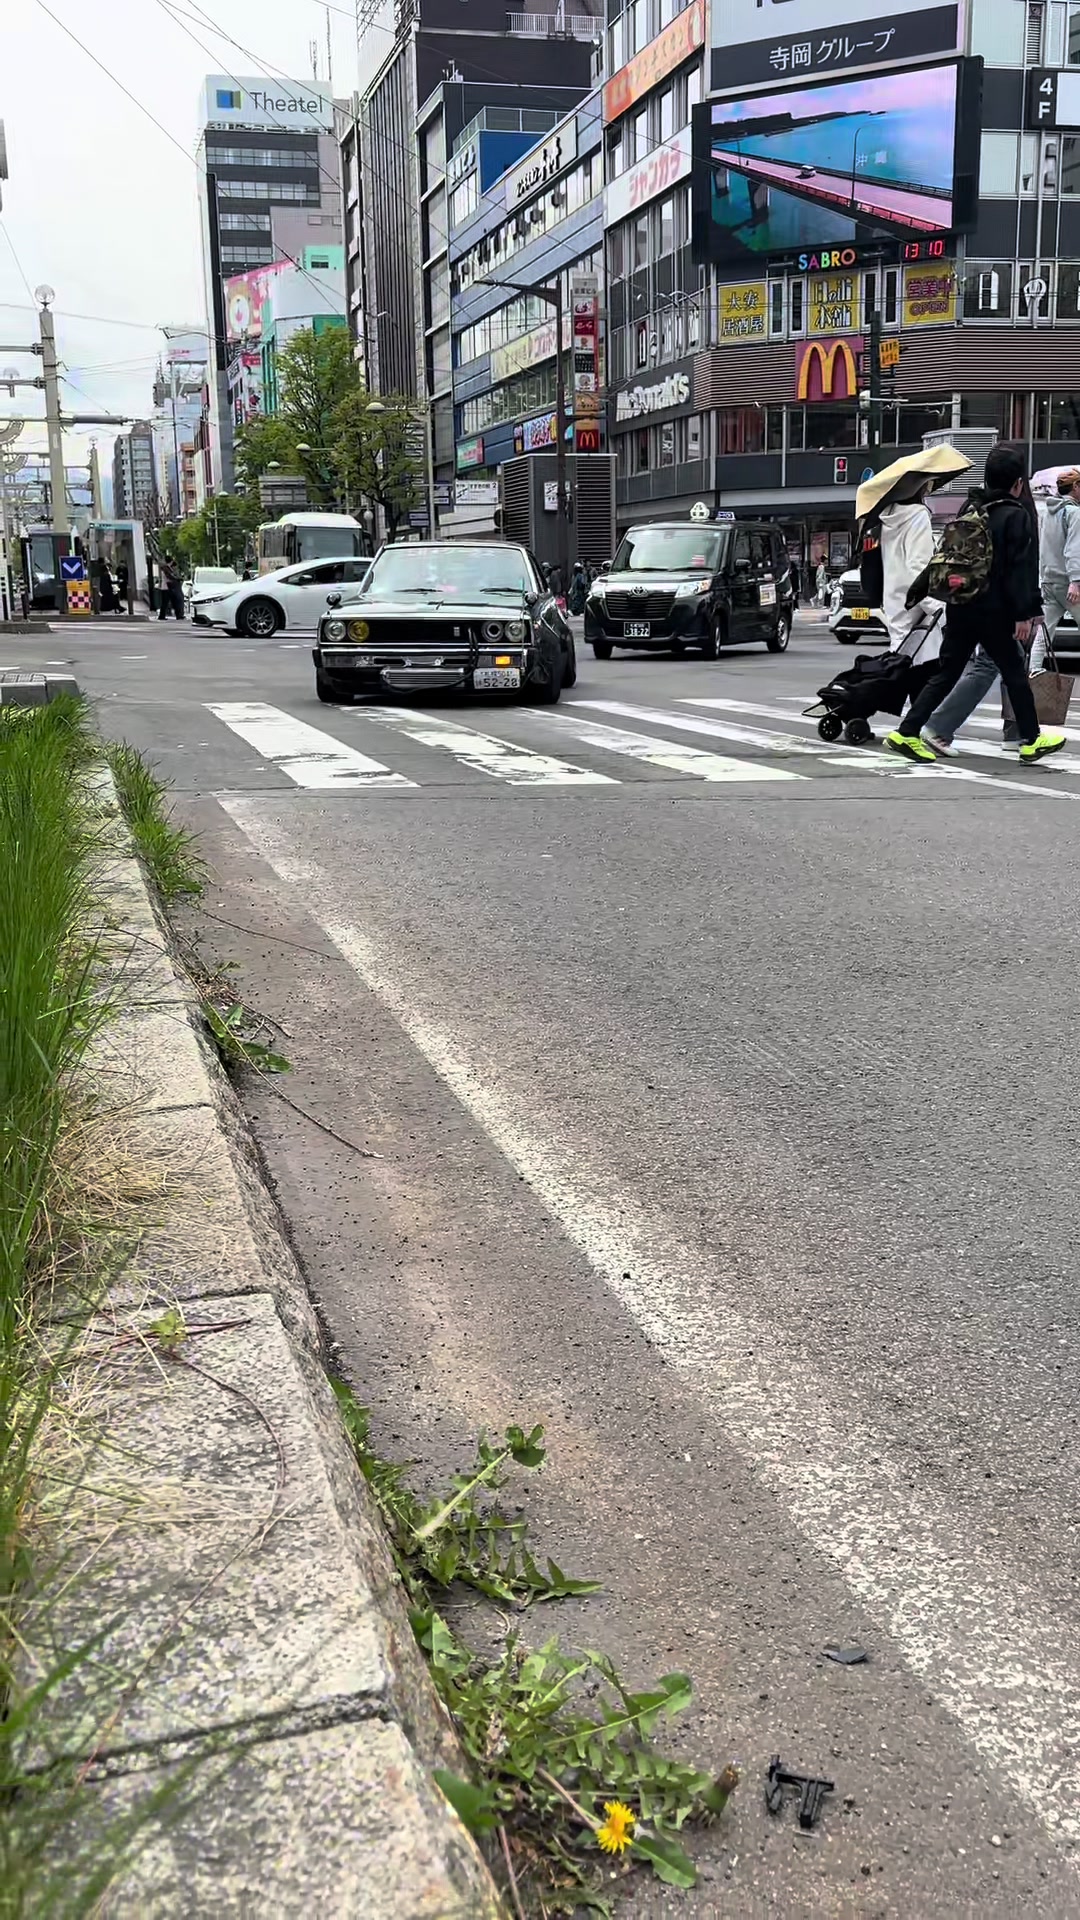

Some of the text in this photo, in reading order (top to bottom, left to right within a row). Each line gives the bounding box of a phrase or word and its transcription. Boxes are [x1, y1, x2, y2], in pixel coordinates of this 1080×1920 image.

[769, 28, 896, 71] 寺岡グループ
[250, 91, 324, 114] Theatel
[798, 248, 856, 271] SABRO
[904, 240, 944, 259] 13 10
[909, 300, 949, 316] OPEN
[721, 315, 765, 337] 居酒屋
[616, 372, 690, 422] McDonald's
[483, 677, 518, 688] 52-28
